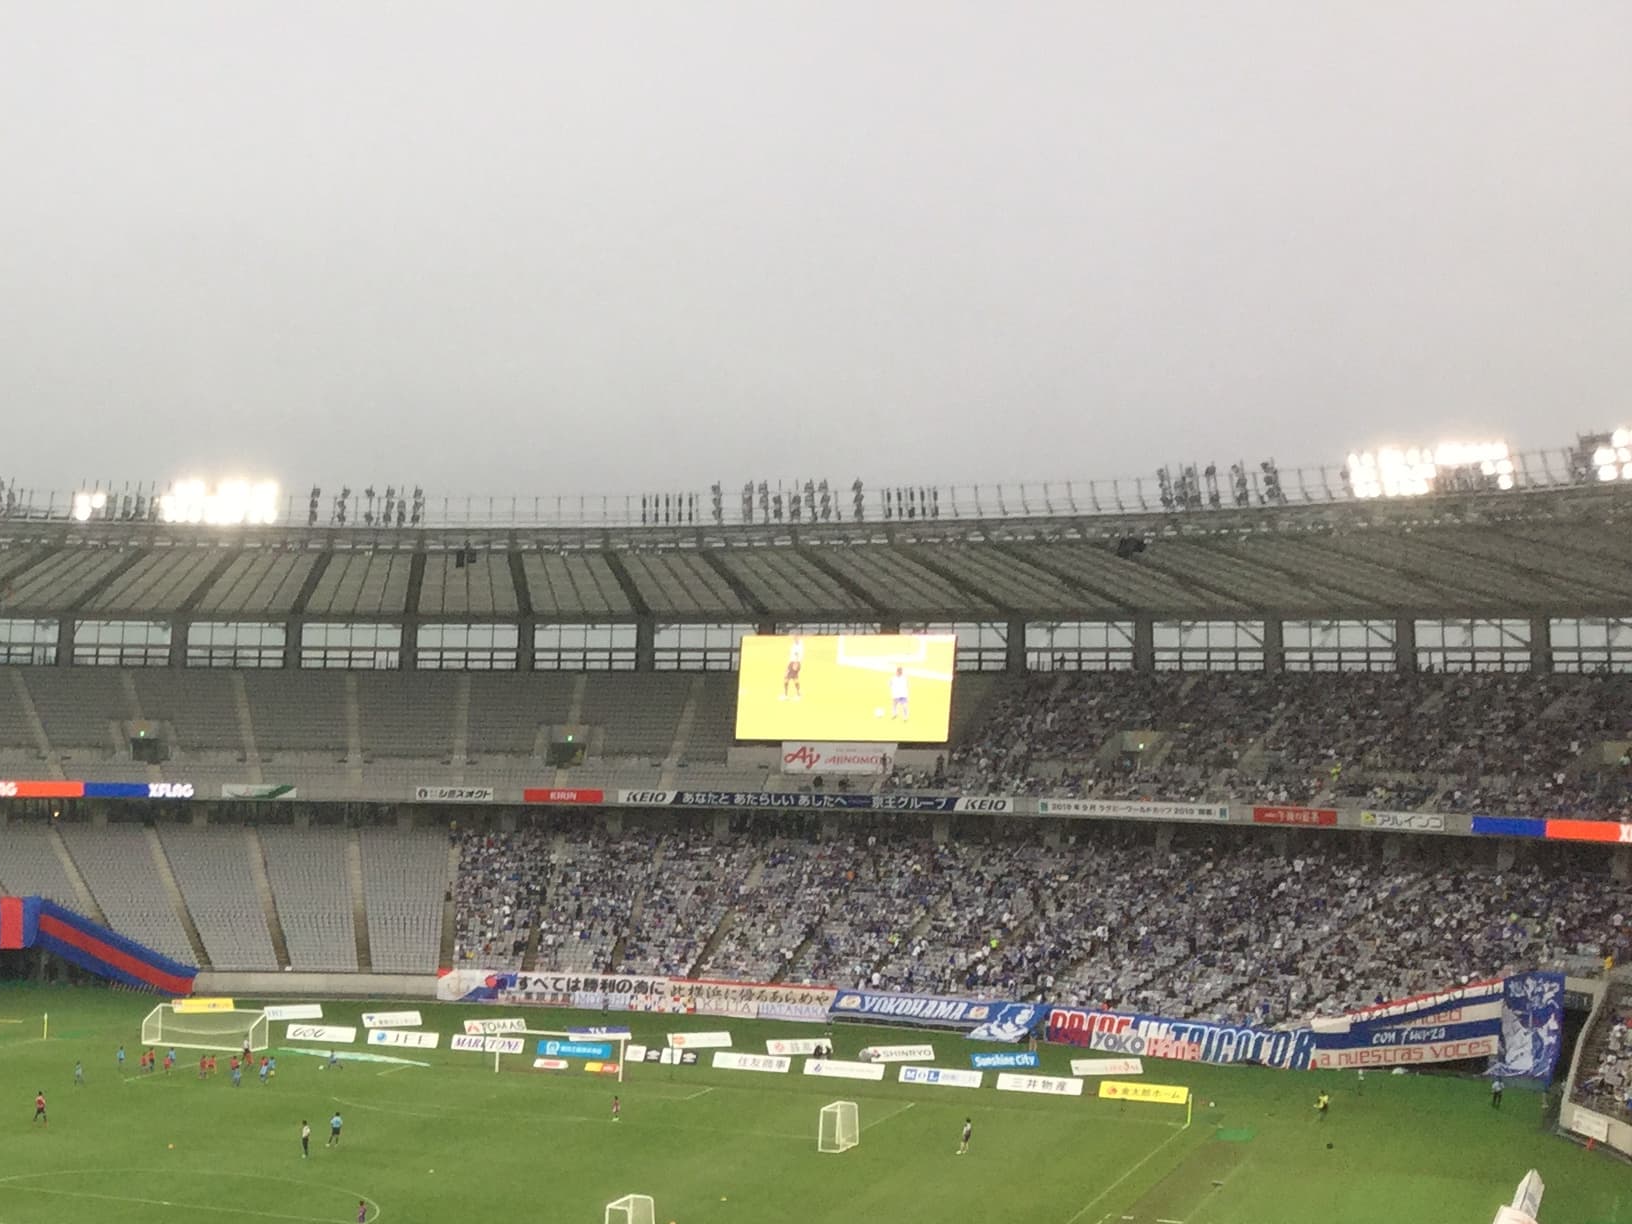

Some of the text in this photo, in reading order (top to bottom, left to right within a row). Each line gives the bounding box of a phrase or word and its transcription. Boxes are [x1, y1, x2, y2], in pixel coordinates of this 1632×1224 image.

[148, 781, 194, 798] XFLAG
[626, 791, 667, 803] KEIO
[682, 792, 947, 810] あなたと あたらしい あしたへ 京王グループ
[964, 799, 1007, 811] KEIO
[1378, 814, 1443, 830] アルインコ
[518, 975, 666, 995] すべては勝利の為に
[860, 996, 967, 1021] YOKOHAMA
[974, 1053, 1036, 1068] Sunshine City
[1338, 1047, 1424, 1066] nuestras
[1429, 1038, 1492, 1058] voces
